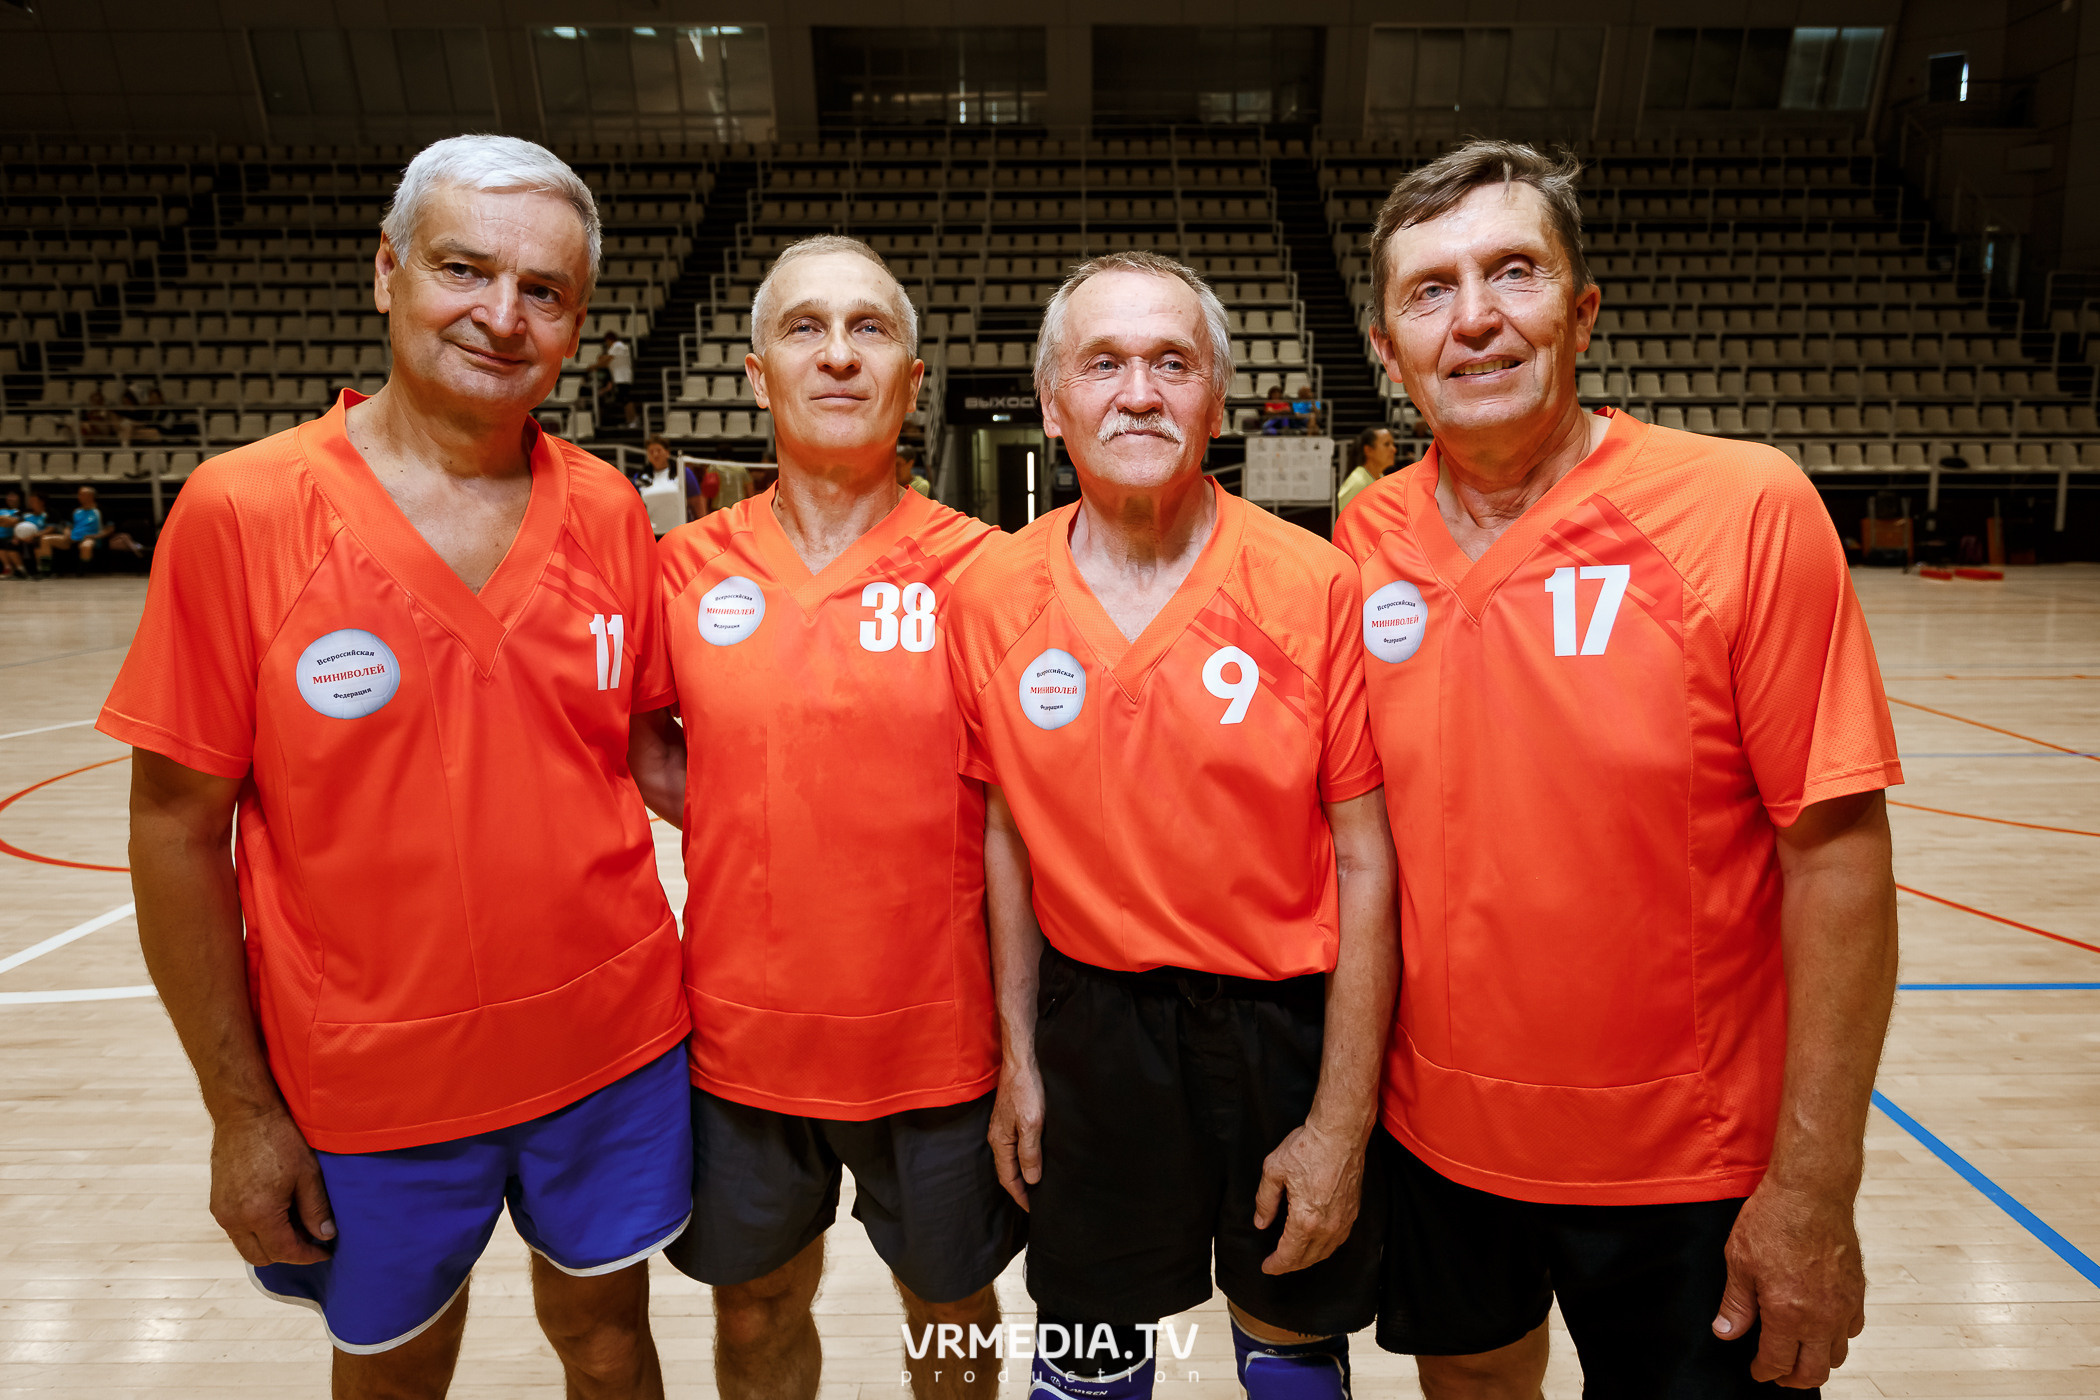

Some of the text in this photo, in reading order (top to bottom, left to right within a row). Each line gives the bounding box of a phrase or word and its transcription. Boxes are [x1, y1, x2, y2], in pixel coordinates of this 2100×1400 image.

[706, 607, 755, 616] МИНИВОЛЕЙ
[859, 581, 936, 653] 38
[1371, 614, 1419, 628] МИНИВОЛЕЙ
[1544, 564, 1630, 657] 17
[316, 649, 375, 666] Всероссийская
[588, 613, 624, 691] 11
[312, 663, 386, 685] МИНИВОЛЕЙ
[1201, 645, 1260, 725] 9
[333, 687, 373, 699] Федерация
